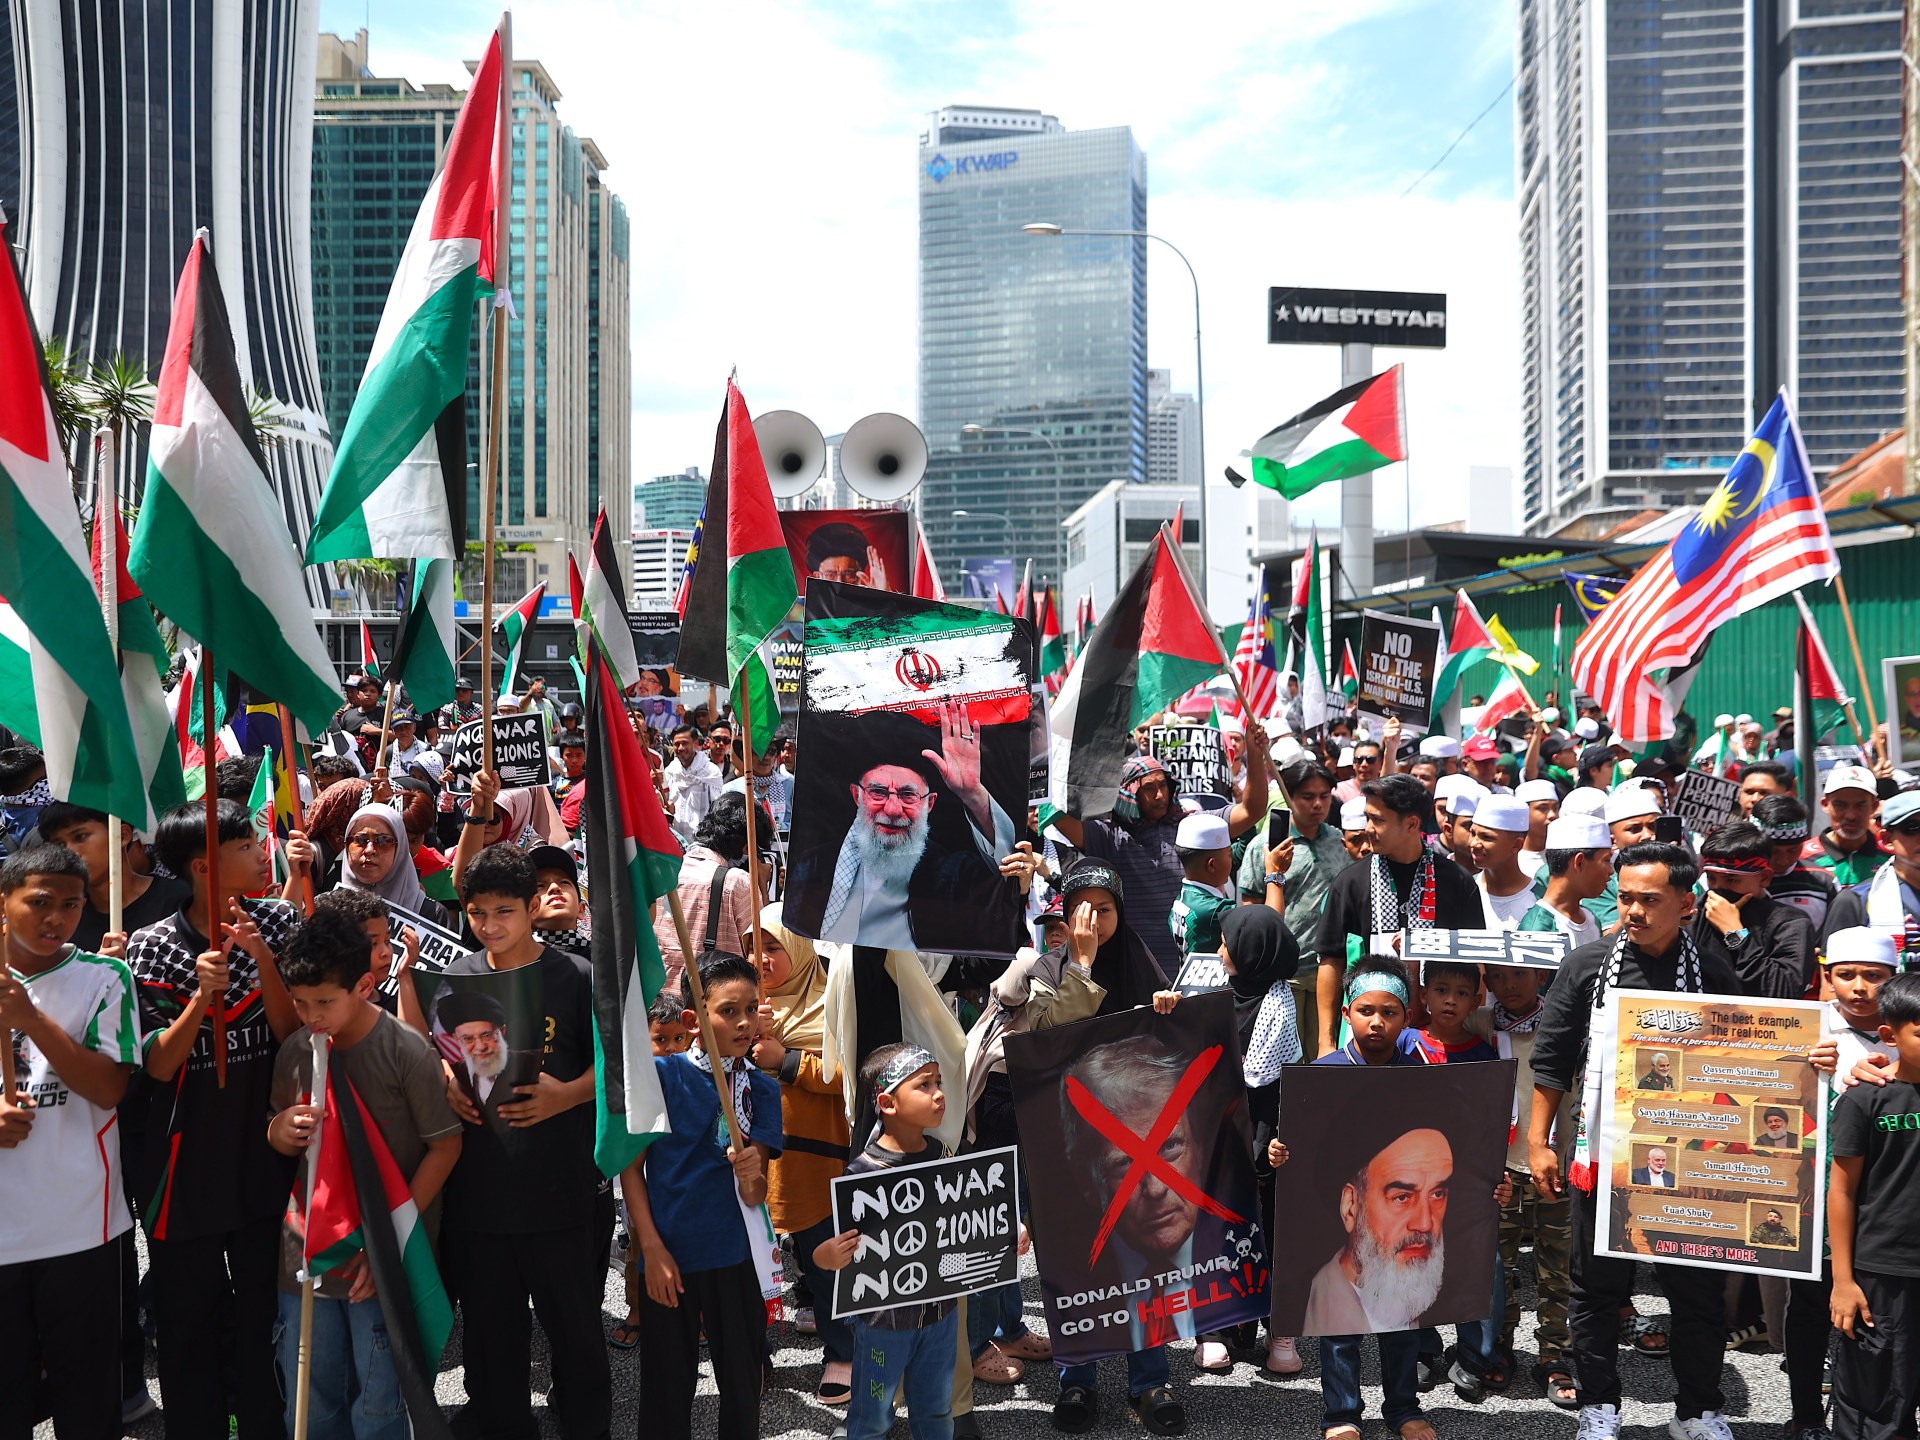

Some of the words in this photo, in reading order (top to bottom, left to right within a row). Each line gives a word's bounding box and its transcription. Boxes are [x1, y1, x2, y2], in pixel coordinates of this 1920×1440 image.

[956, 151, 1018, 174] KWAP
[1294, 305, 1445, 328] WESTSTAR
[507, 530, 543, 538] TOWER
[1383, 631, 1412, 658] NO
[1371, 652, 1390, 673] TO
[1394, 657, 1422, 680] THE
[1366, 669, 1423, 694] ISRAELI-U.S.
[1363, 682, 1384, 698] WAR
[1385, 689, 1397, 702] ON
[1398, 693, 1425, 708] IRAN!
[493, 719, 537, 740] WAR
[495, 741, 541, 763] ZIONIS
[1683, 787, 1733, 813] PERANG
[1180, 959, 1230, 987] BERSA
[1711, 1011, 1729, 1024] The
[1732, 1013, 1755, 1026] best
[1648, 1034, 1669, 1044] value
[1670, 1036, 1682, 1045] of
[1689, 1038, 1719, 1048] person
[1720, 1039, 1729, 1047] is
[1729, 1040, 1751, 1049] what
[1751, 1041, 1762, 1050] he
[1762, 1042, 1784, 1051] does
[1711, 1025, 1729, 1037] The
[1731, 1026, 1751, 1038] real
[1754, 1027, 1778, 1041] icon.
[227, 1054, 253, 1064] ACRED
[1703, 1064, 1734, 1076] Qassem
[1735, 1066, 1779, 1078] Sulaimani
[31, 1082, 59, 1093] FOR
[1638, 1107, 1666, 1119] Sayyid
[1666, 1108, 1698, 1120] Hassan
[1699, 1111, 1741, 1124] Nasrallah
[1704, 1161, 1732, 1172] Ismail
[1732, 1161, 1770, 1175] Haniyeh
[934, 1162, 1006, 1204] WAR
[1663, 1205, 1685, 1216] Fuad
[1686, 1207, 1712, 1219] Shukr
[935, 1202, 1009, 1249] ZIONIS
[1656, 1240, 1678, 1253] AND
[1680, 1242, 1724, 1259] THERE'S
[1726, 1248, 1759, 1263] MORE.
[1056, 1278, 1151, 1310] DONALD
[1153, 1254, 1231, 1287] TRUMP
[1060, 1319, 1095, 1336] GO
[1097, 1309, 1130, 1328] TO
